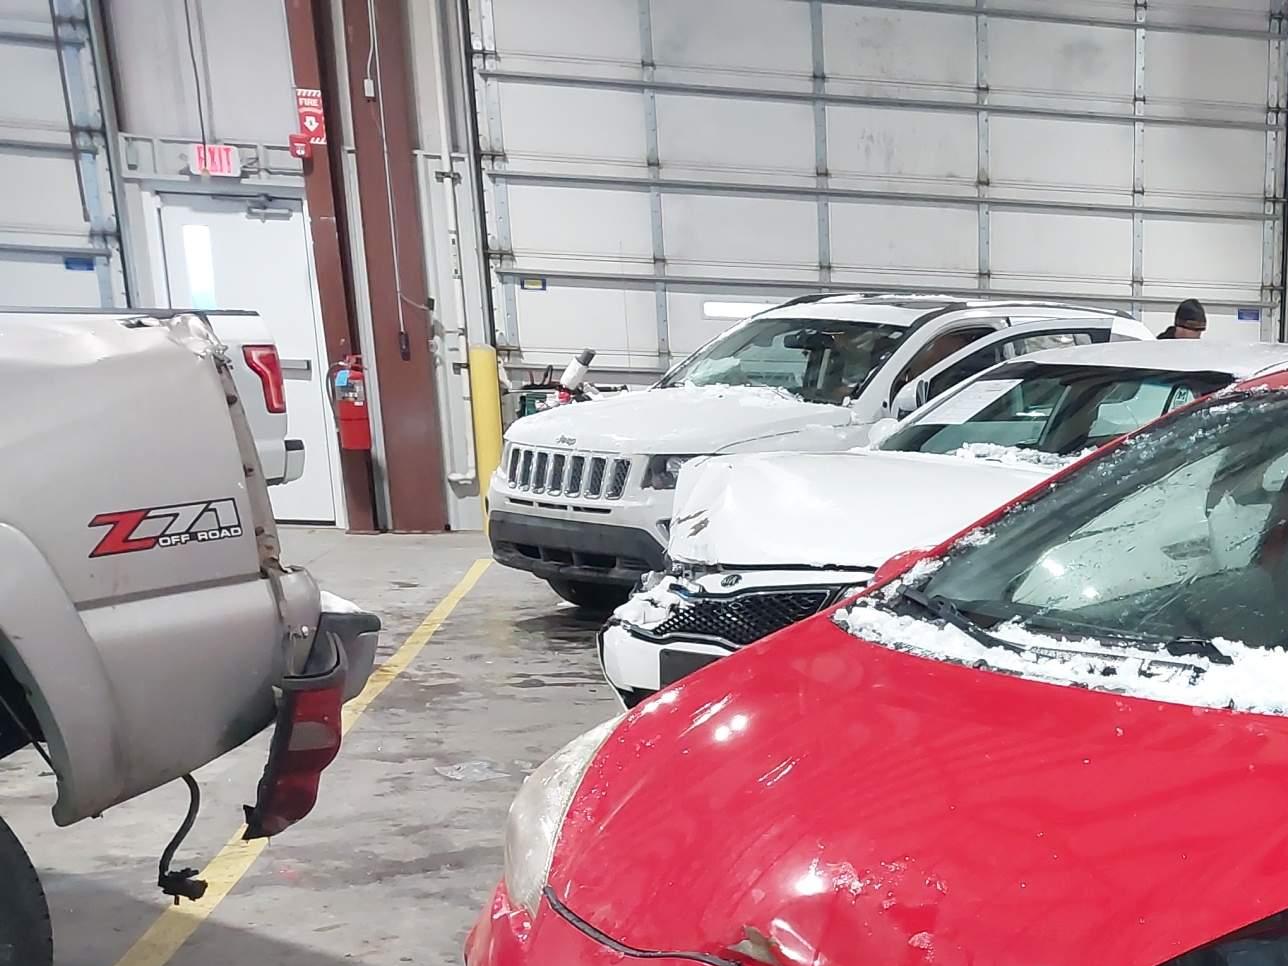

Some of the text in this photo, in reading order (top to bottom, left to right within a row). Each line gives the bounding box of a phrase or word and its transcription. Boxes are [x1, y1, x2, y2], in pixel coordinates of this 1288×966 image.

[299, 97, 319, 106] FIRE
[196, 146, 232, 173] EXIT
[88, 498, 241, 559] Z71
[158, 525, 243, 547] OFF ROAD
